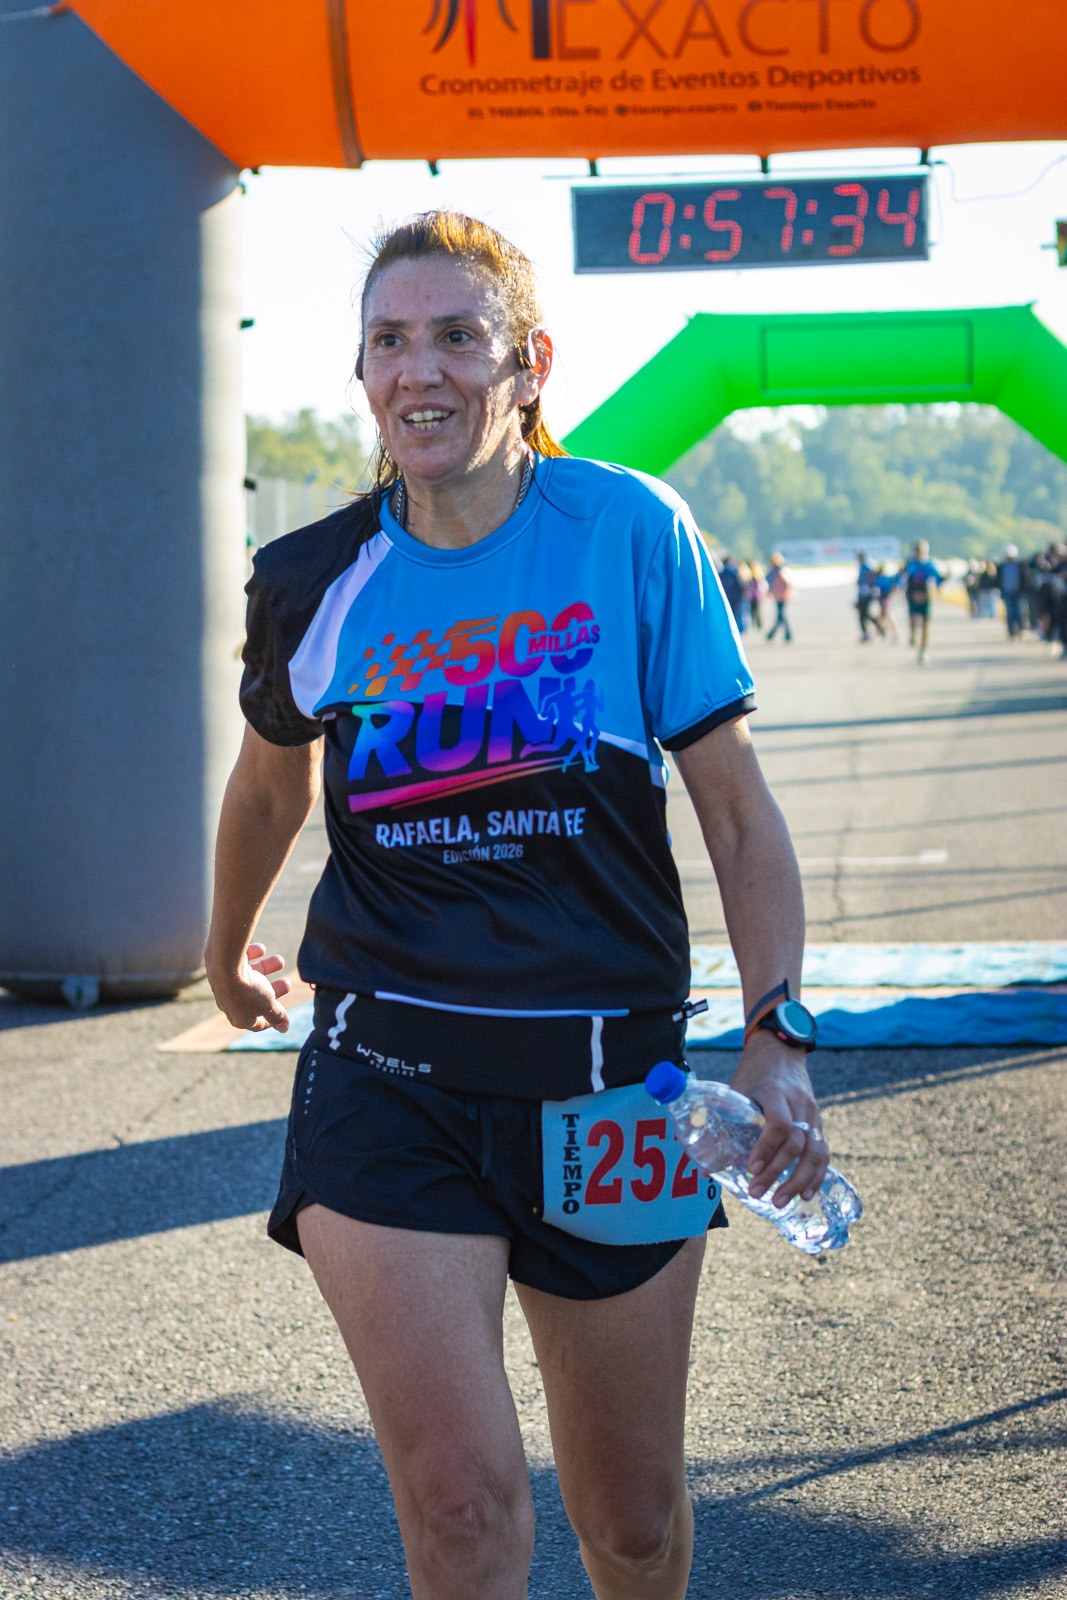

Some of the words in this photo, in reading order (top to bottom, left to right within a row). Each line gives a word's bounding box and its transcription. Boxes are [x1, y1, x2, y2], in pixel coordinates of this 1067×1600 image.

[419, 72, 604, 96] Cronometraje
[609, 70, 645, 92] de
[652, 68, 761, 91] Eventos
[766, 65, 922, 90] Deportivos
[528, 624, 600, 655] MILLAS
[347, 676, 562, 781] RUN
[375, 814, 480, 849] RAFAELA,
[487, 809, 560, 836] SANTA
[563, 807, 586, 837] FE
[443, 846, 490, 865] EDICIÓN
[493, 844, 524, 860] 2026
[561, 1113, 582, 1214] TIEMPO
